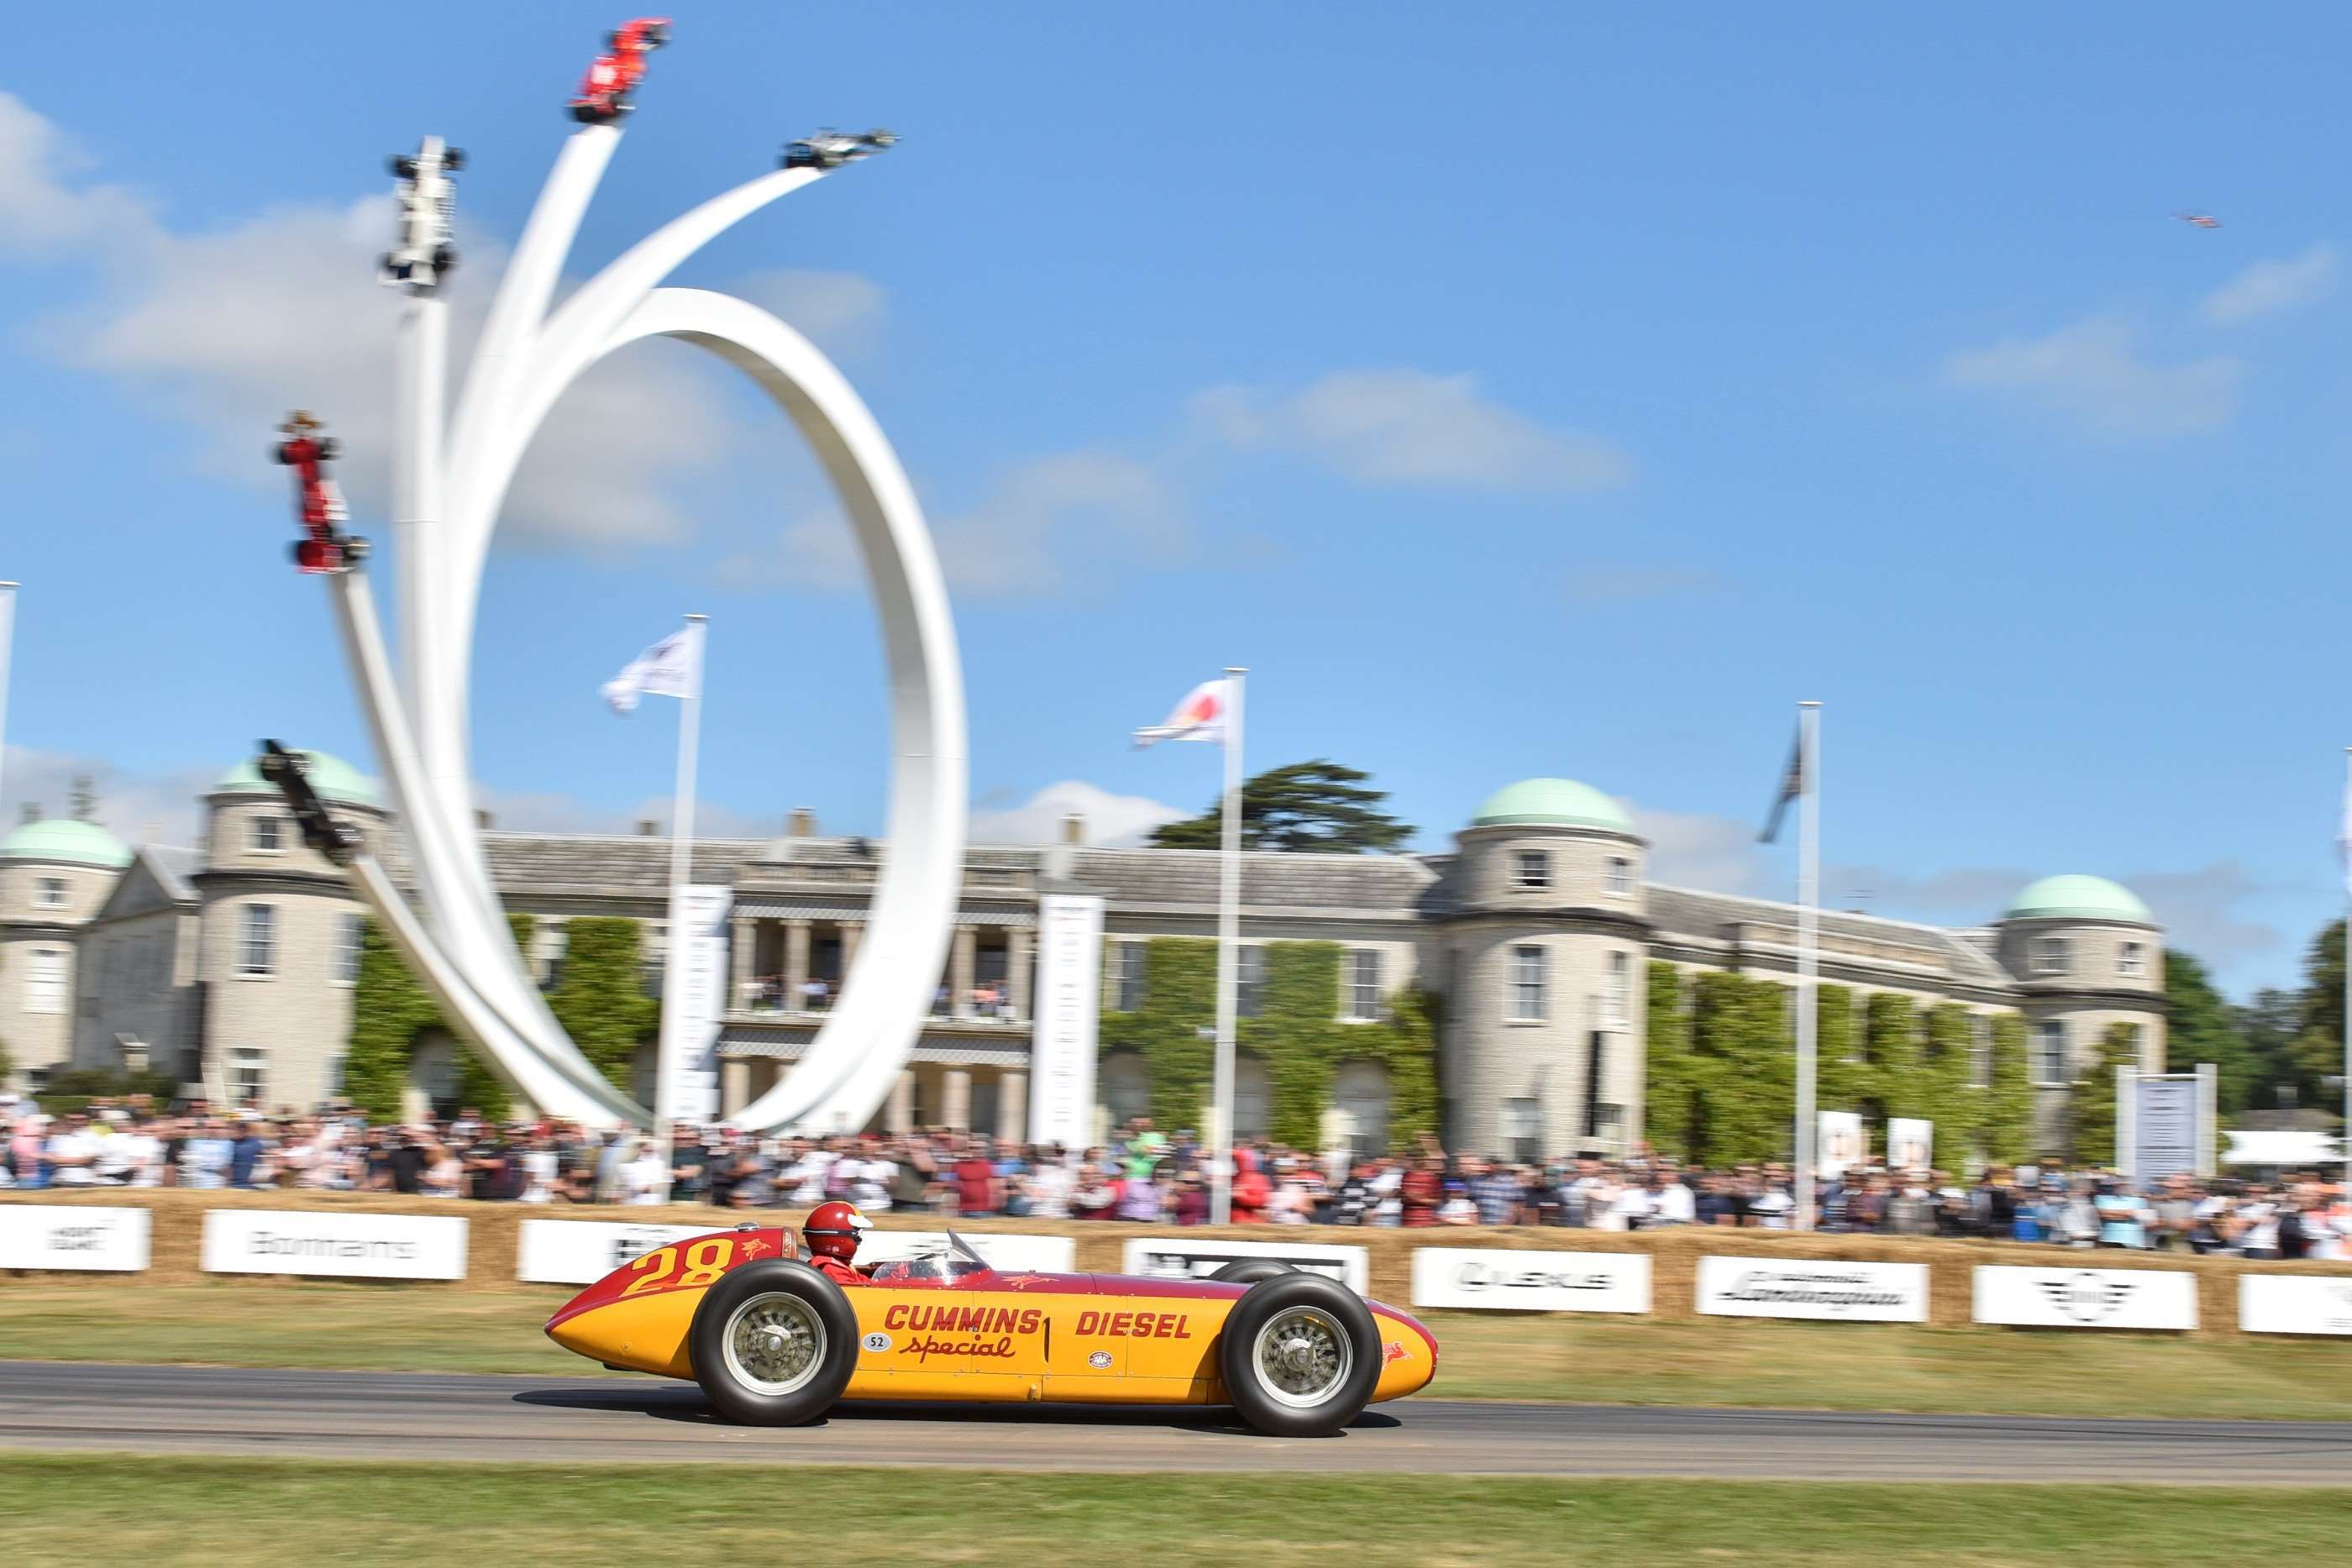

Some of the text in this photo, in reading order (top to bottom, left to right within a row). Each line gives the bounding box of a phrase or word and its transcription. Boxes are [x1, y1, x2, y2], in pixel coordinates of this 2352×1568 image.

[249, 1230, 418, 1260] Bonhams
[618, 1239, 735, 1298] 28
[885, 1304, 1191, 1339] CUMMINS DIESEL
[870, 1336, 884, 1347] 52
[898, 1334, 1016, 1364] special
